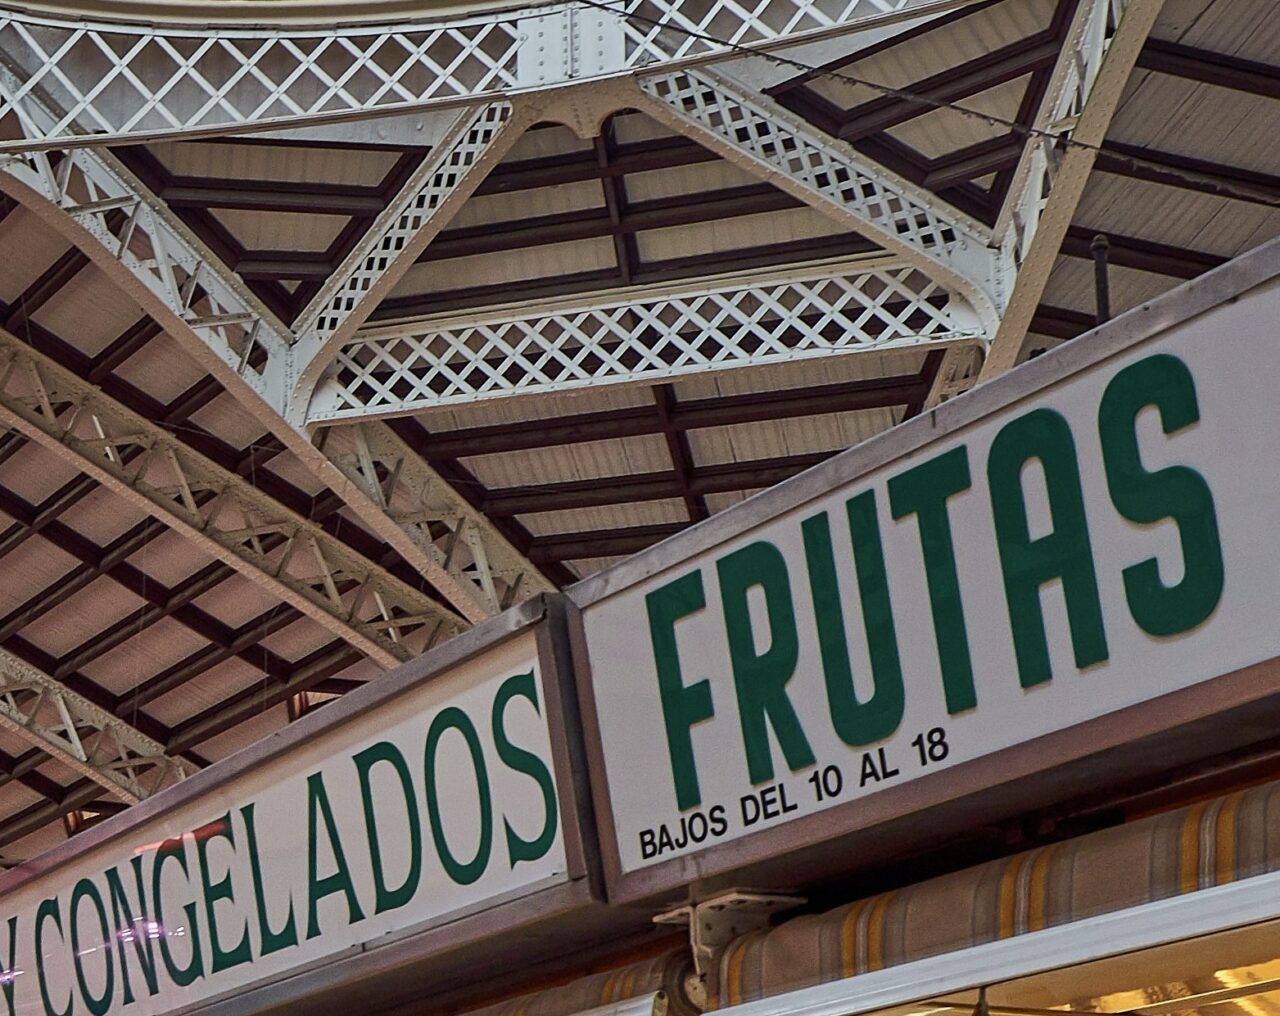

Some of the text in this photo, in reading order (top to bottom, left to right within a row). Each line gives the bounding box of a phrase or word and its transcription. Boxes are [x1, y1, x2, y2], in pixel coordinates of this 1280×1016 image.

[645, 352, 1225, 813] FRUTAS
[638, 725, 950, 860] BAJOS DEL 10 AL 18
